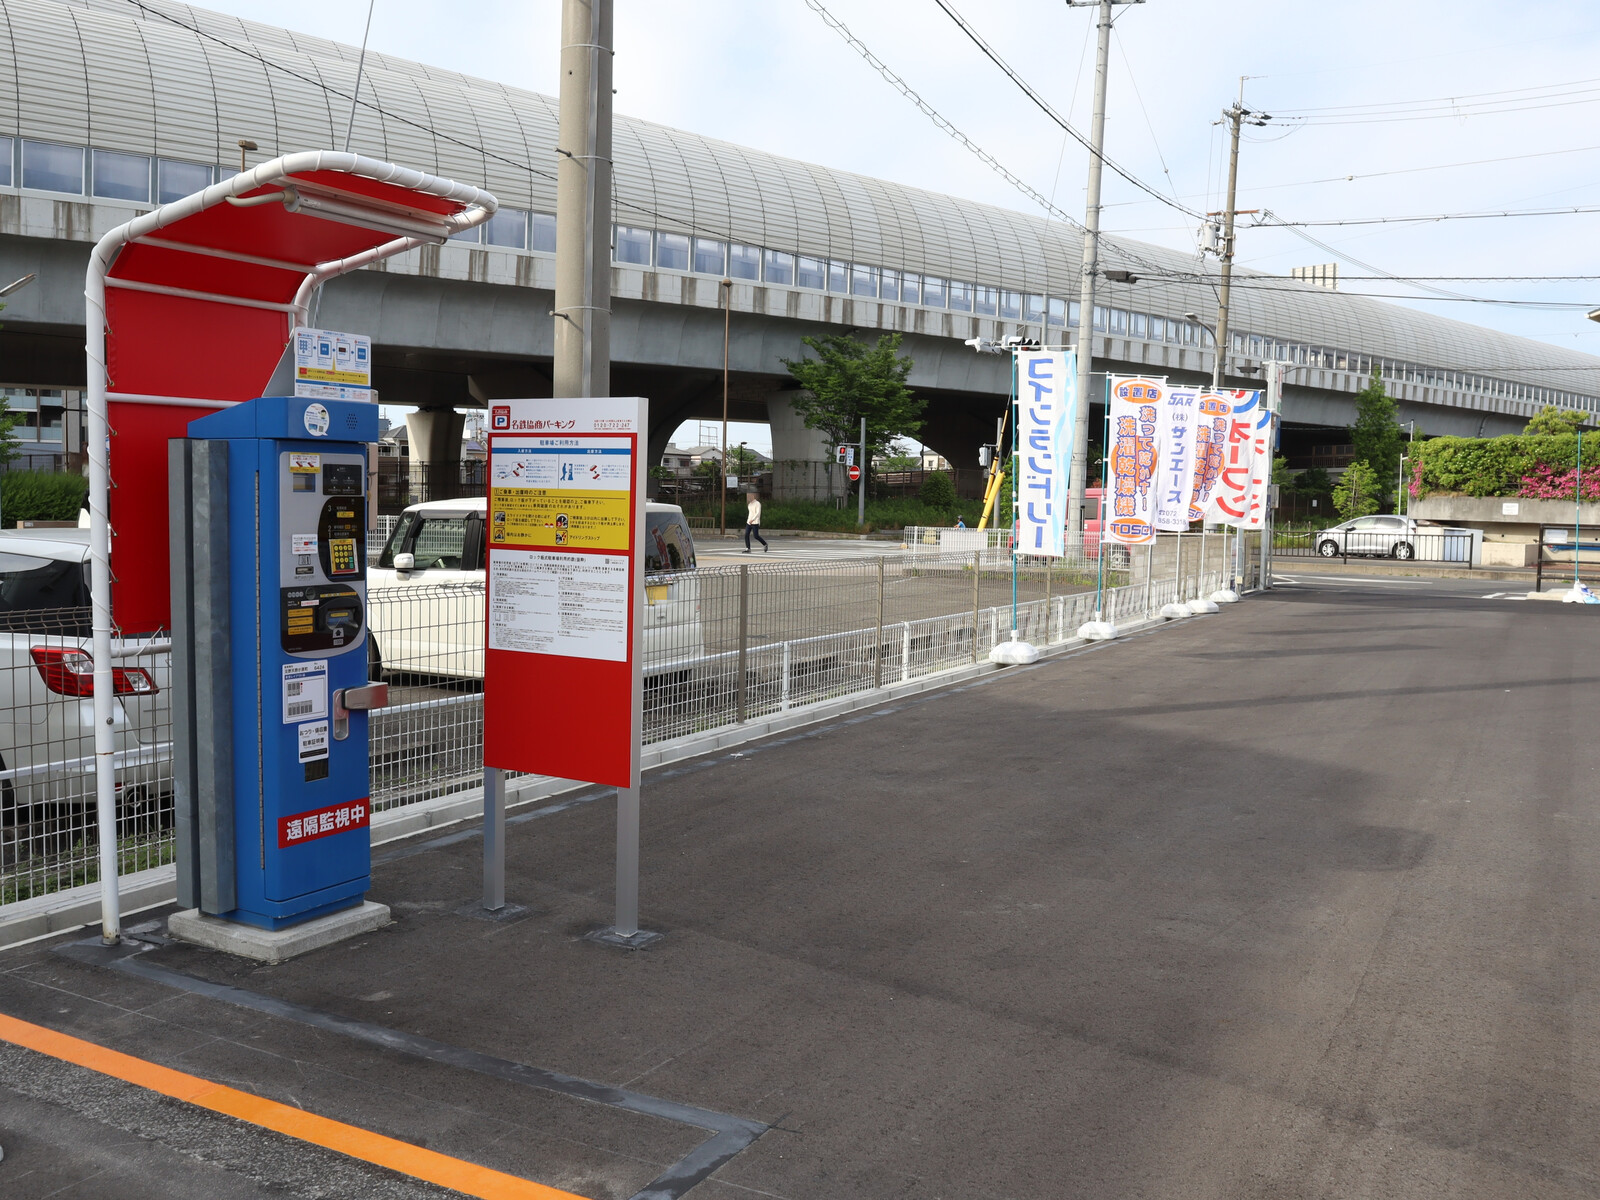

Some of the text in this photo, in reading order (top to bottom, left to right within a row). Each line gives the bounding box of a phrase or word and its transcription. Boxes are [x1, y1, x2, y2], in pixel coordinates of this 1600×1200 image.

[1119, 387, 1158, 399] 設置店
[497, 417, 505, 426] P
[511, 420, 576, 430] 名鉄協商パーキング
[1114, 415, 1137, 517] 洗濯乾燥機
[303, 737, 325, 746] 駐車証明書
[286, 804, 365, 841] 遠隔監視中
